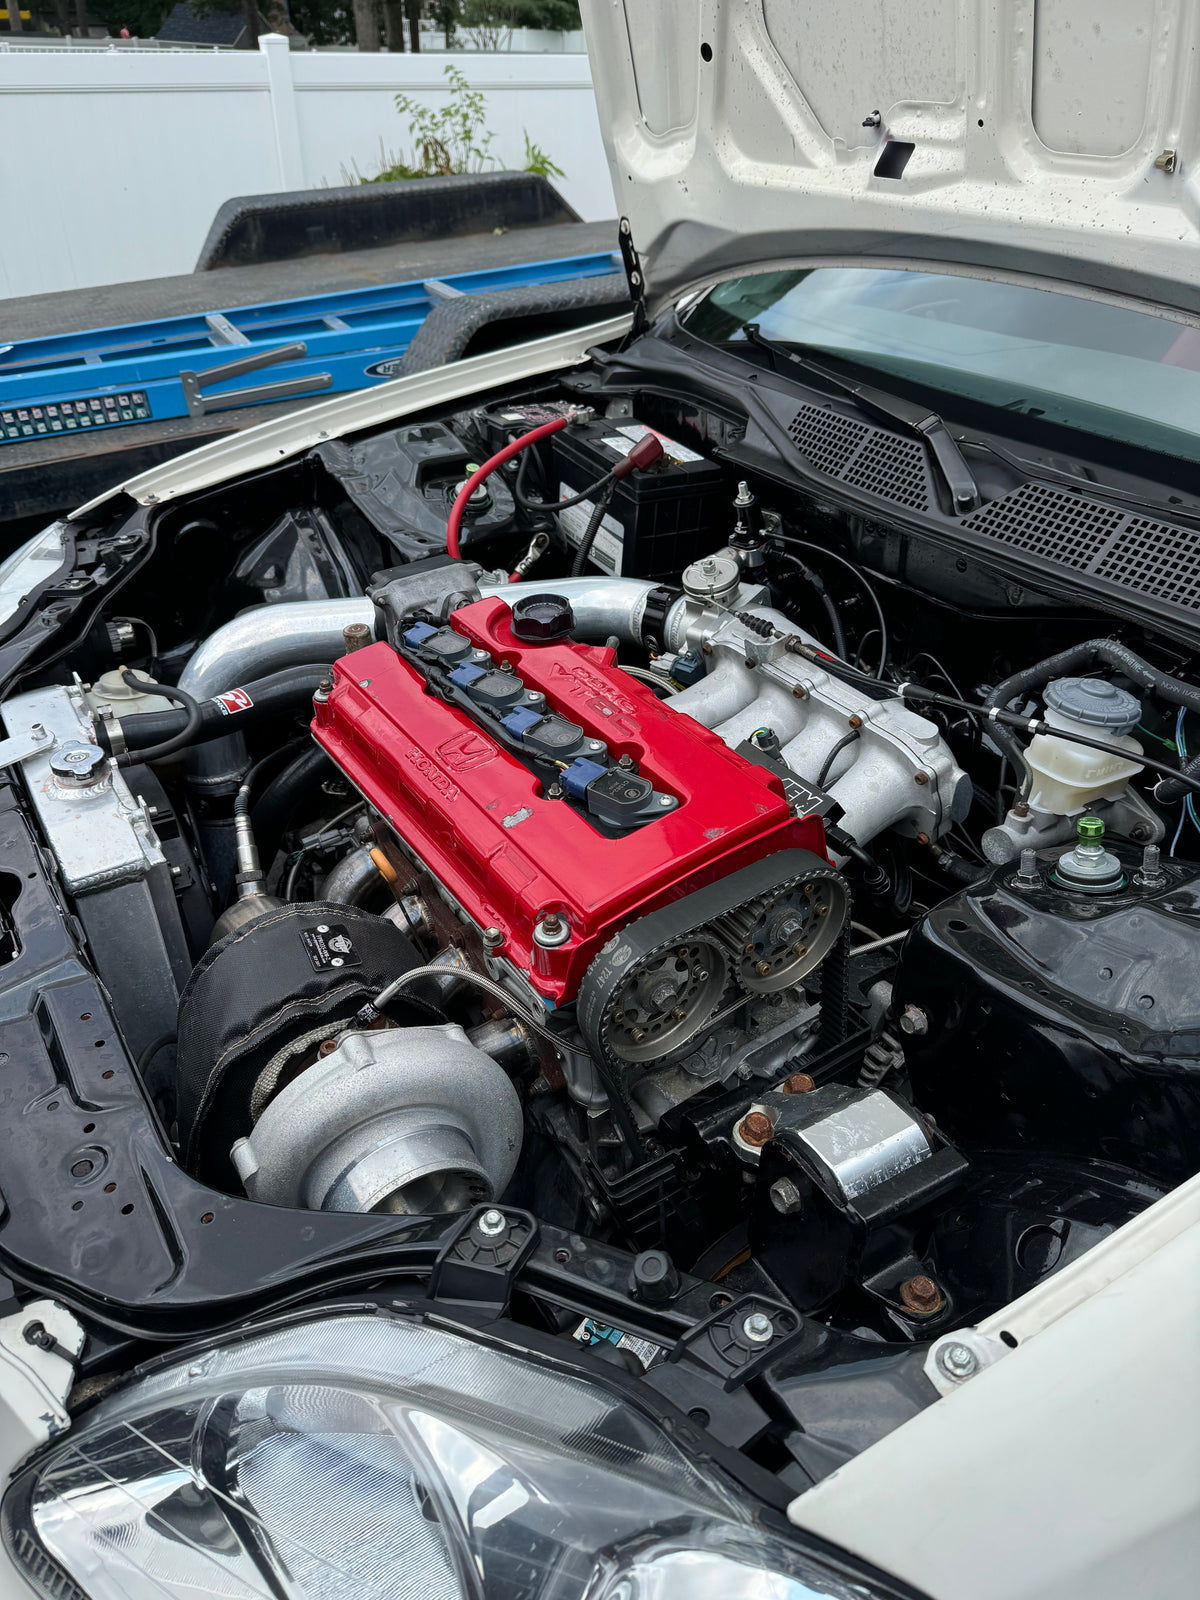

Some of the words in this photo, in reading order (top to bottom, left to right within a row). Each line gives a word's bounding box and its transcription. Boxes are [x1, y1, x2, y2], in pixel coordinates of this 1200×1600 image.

[549, 662, 642, 738] VTEC
[404, 746, 460, 803] HONDA
[782, 777, 823, 815] EM
[596, 967, 612, 989] T247
